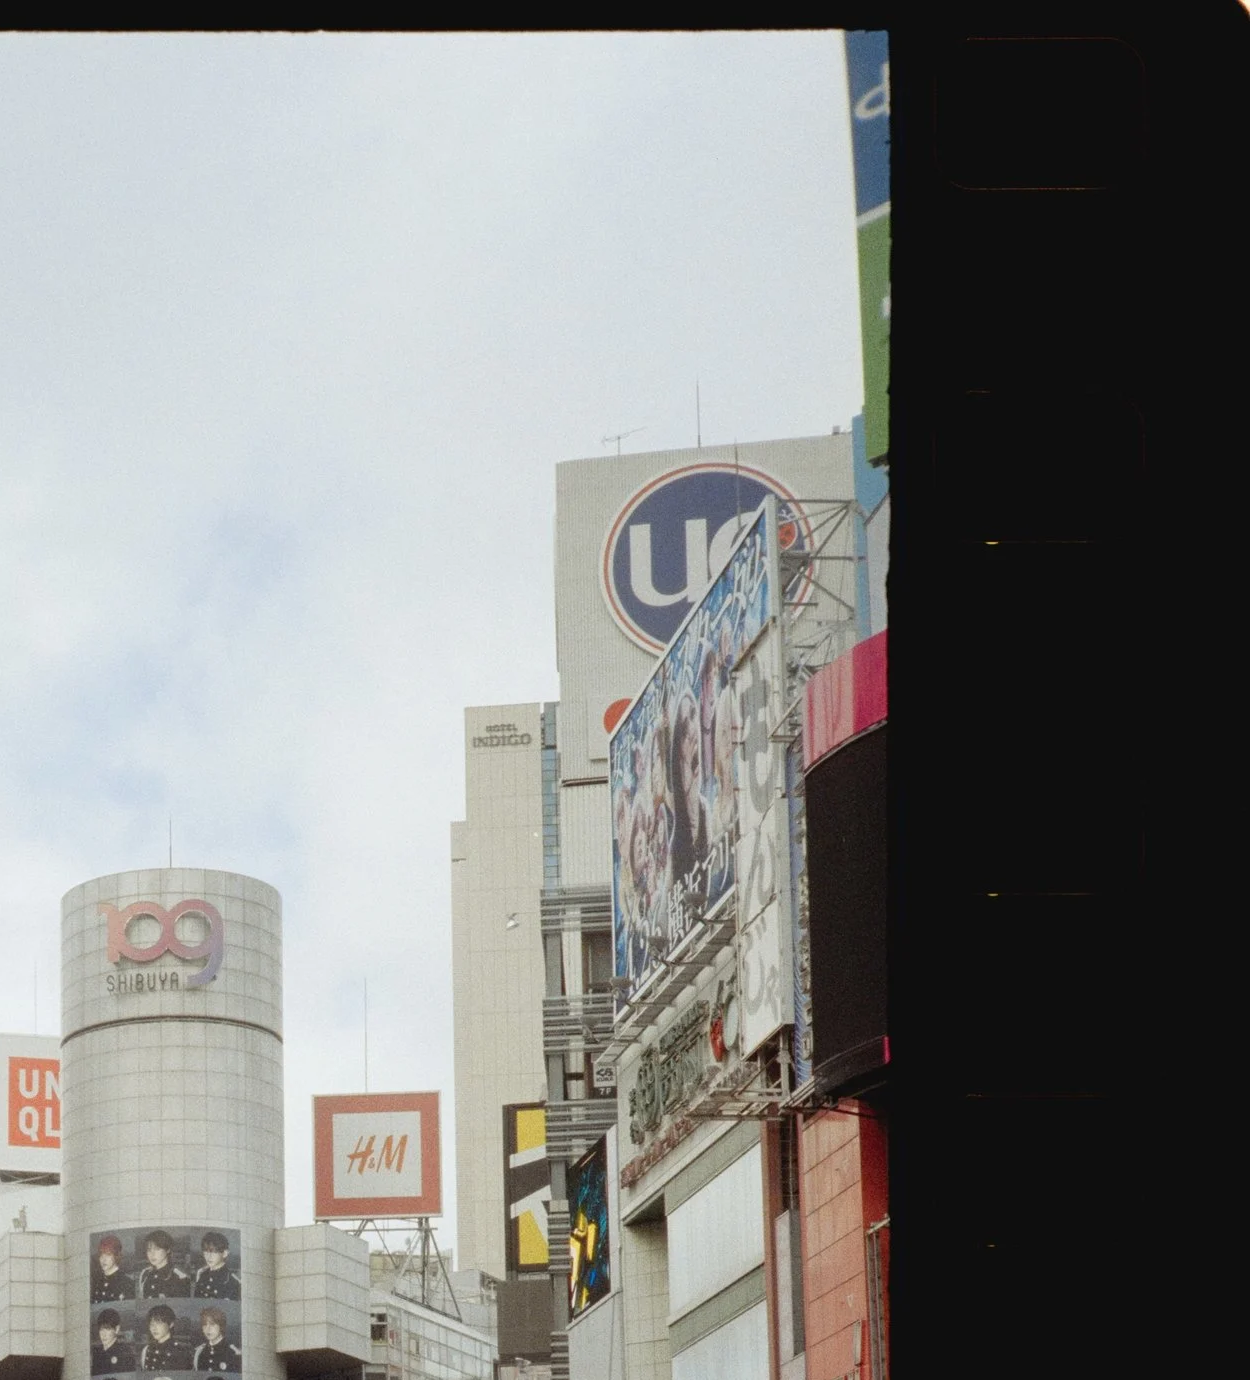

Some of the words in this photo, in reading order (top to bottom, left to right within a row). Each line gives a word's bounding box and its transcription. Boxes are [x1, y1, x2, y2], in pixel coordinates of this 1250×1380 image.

[473, 733, 532, 748] INDIGO
[99, 899, 225, 989] 109
[106, 972, 181, 993] SHIBUYA
[18, 1069, 61, 1100] UN
[18, 1106, 61, 1142] QL
[347, 1133, 408, 1175] H&M
